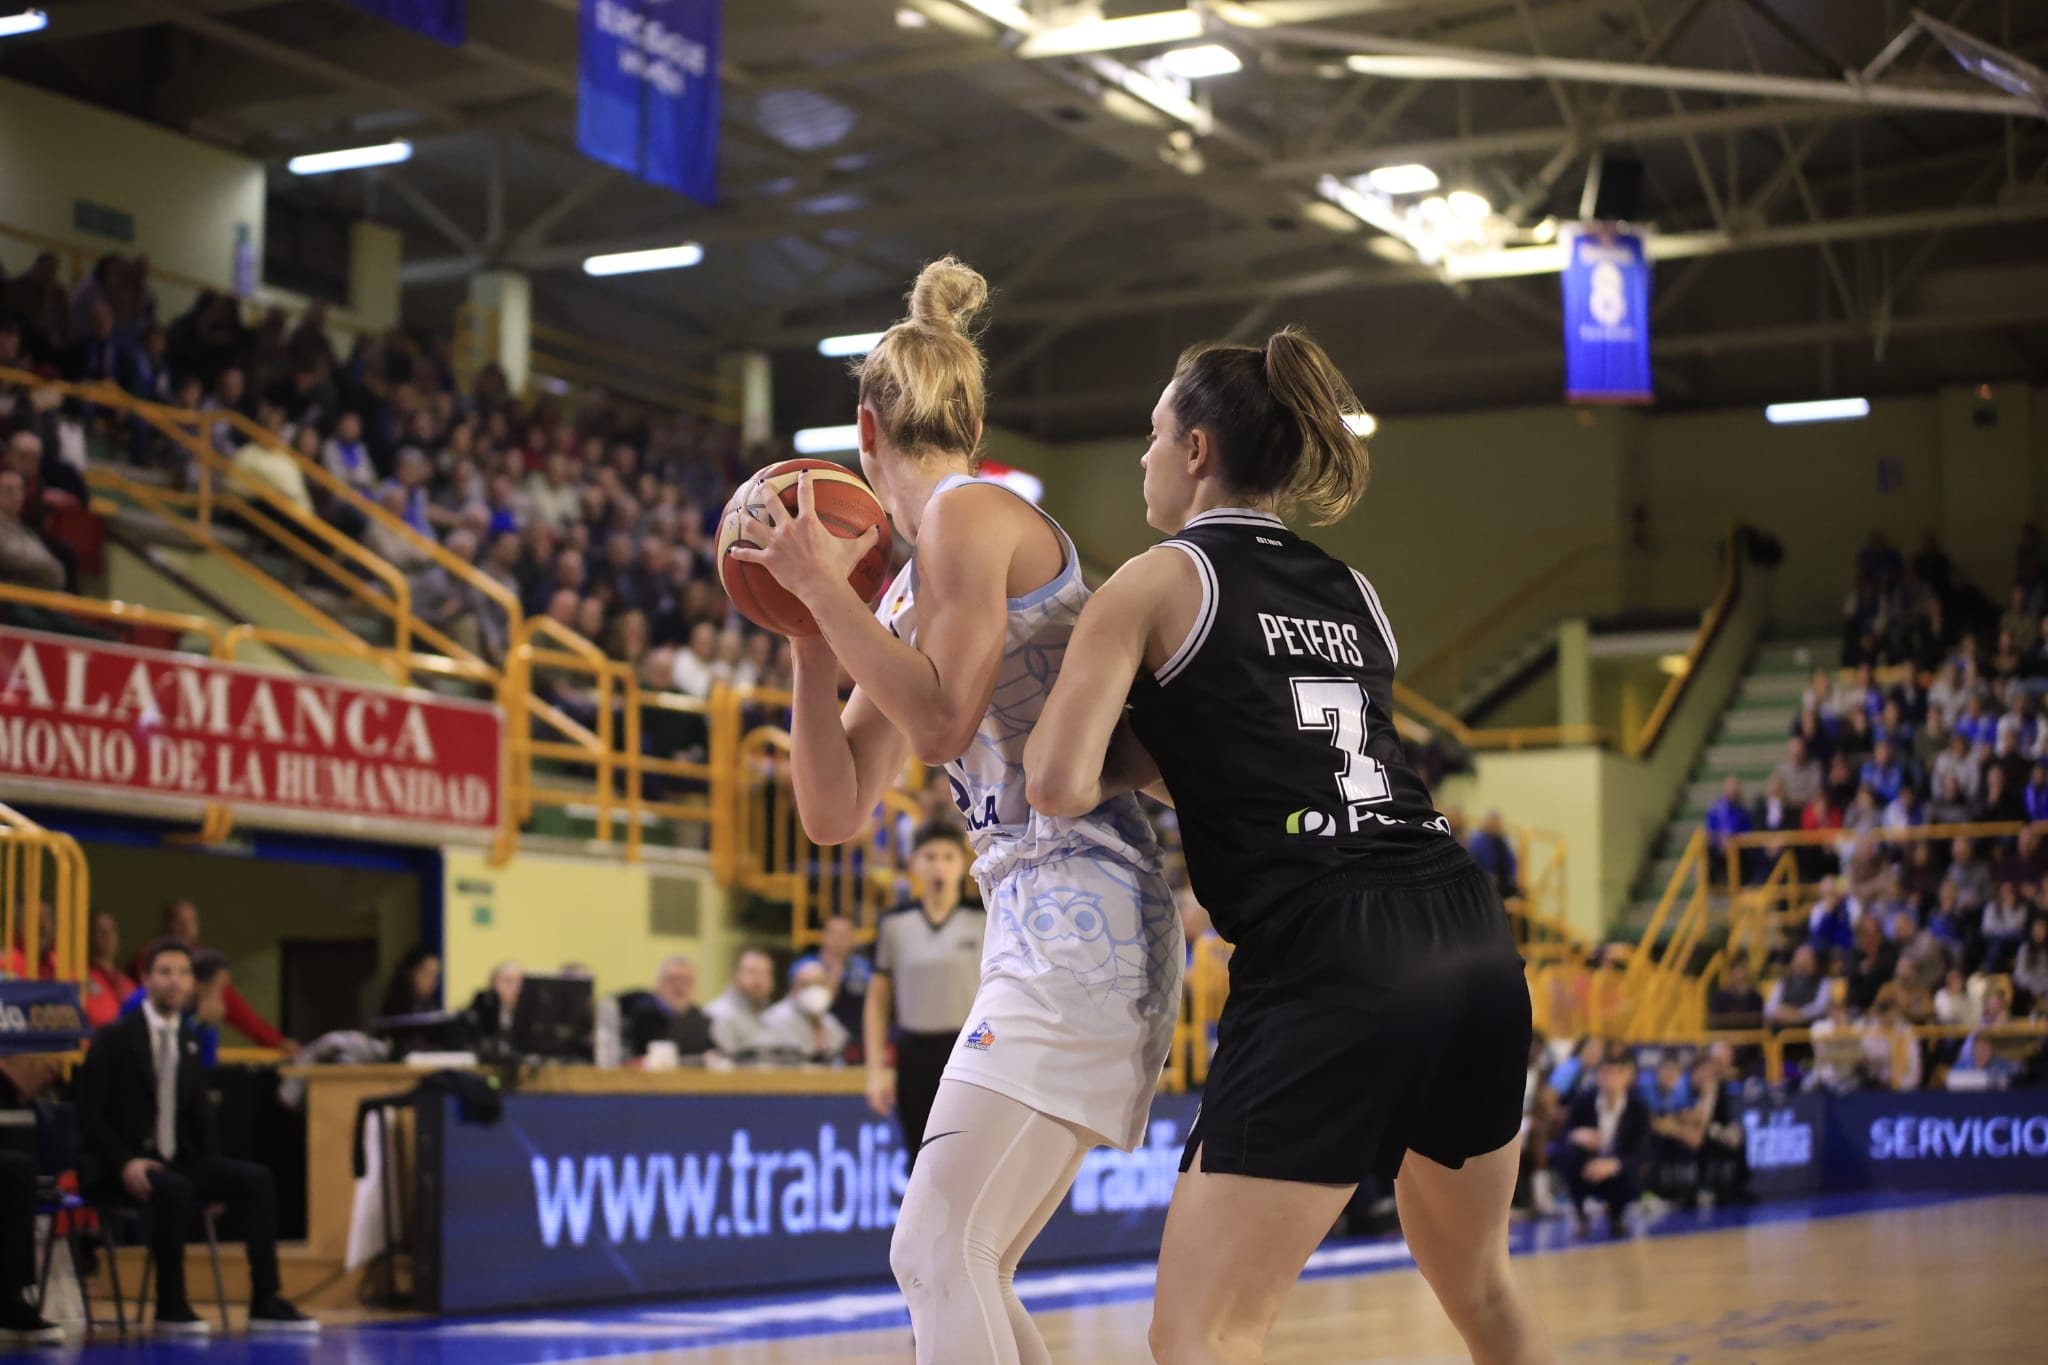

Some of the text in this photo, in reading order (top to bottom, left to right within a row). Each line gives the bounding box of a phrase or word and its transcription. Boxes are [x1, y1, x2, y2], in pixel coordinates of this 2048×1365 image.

[1258, 613, 1364, 668] PETERS
[1289, 677, 1392, 806] 7
[149, 734, 206, 792] DE
[216, 744, 266, 800] LA
[276, 750, 491, 822] HUMANIDAD
[1869, 1115, 2048, 1160] SERVICIO
